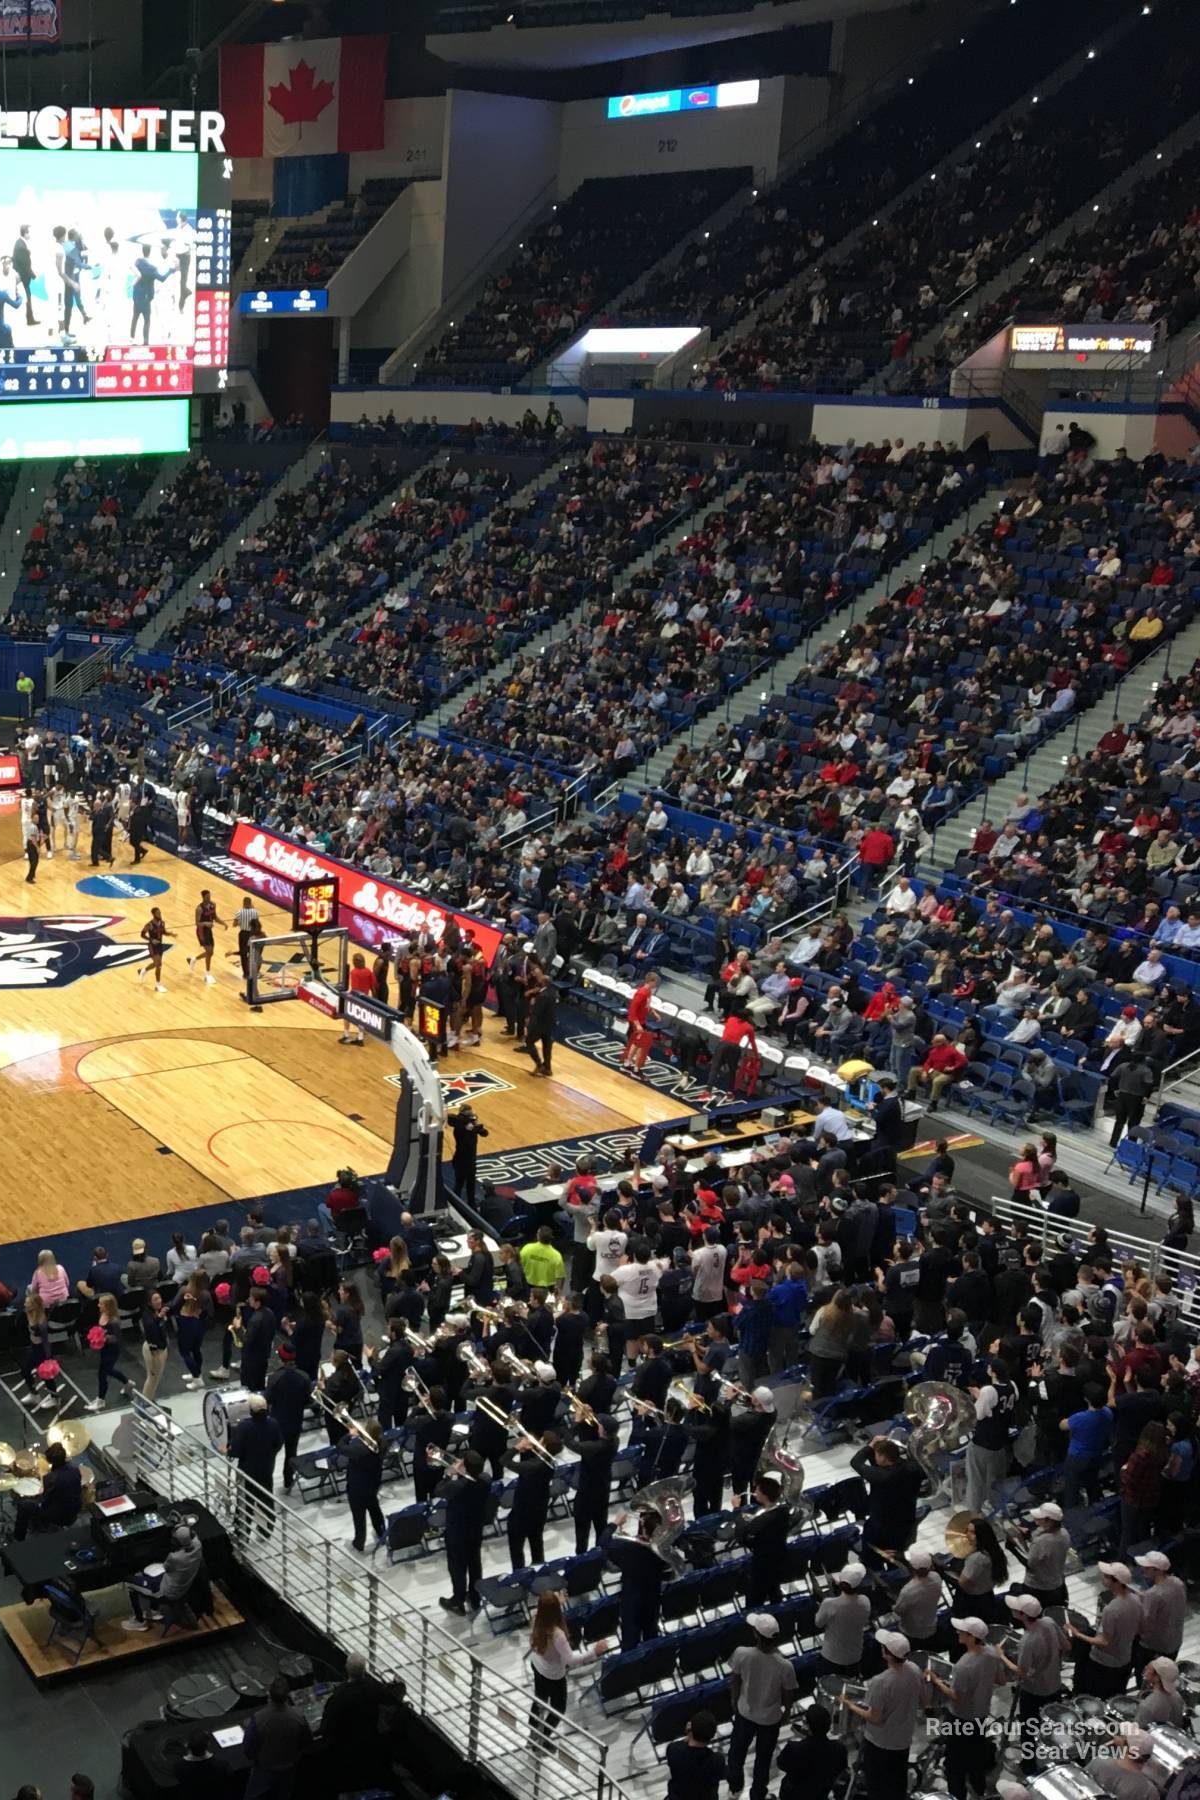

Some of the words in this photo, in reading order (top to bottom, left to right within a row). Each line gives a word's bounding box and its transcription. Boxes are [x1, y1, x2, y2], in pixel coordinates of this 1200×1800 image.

[34, 106, 226, 152] CENTER
[658, 139, 678, 153] 212
[1068, 338, 1152, 353] WatchForMeCT.org
[29, 378, 37, 391] 2
[46, 377, 53, 389] 1
[61, 377, 70, 389] 0
[78, 377, 85, 389] 1
[123, 375, 132, 387] 0
[156, 375, 162, 387] 1
[169, 375, 179, 387] 0
[198, 859, 245, 881] HEALTH
[209, 855, 272, 882] UCONN
[307, 885, 335, 899] 9:30
[305, 900, 329, 925] 30
[346, 1001, 383, 1031] UCONN
[565, 1032, 748, 1112] UCONN
[638, 1277, 649, 1295] 15
